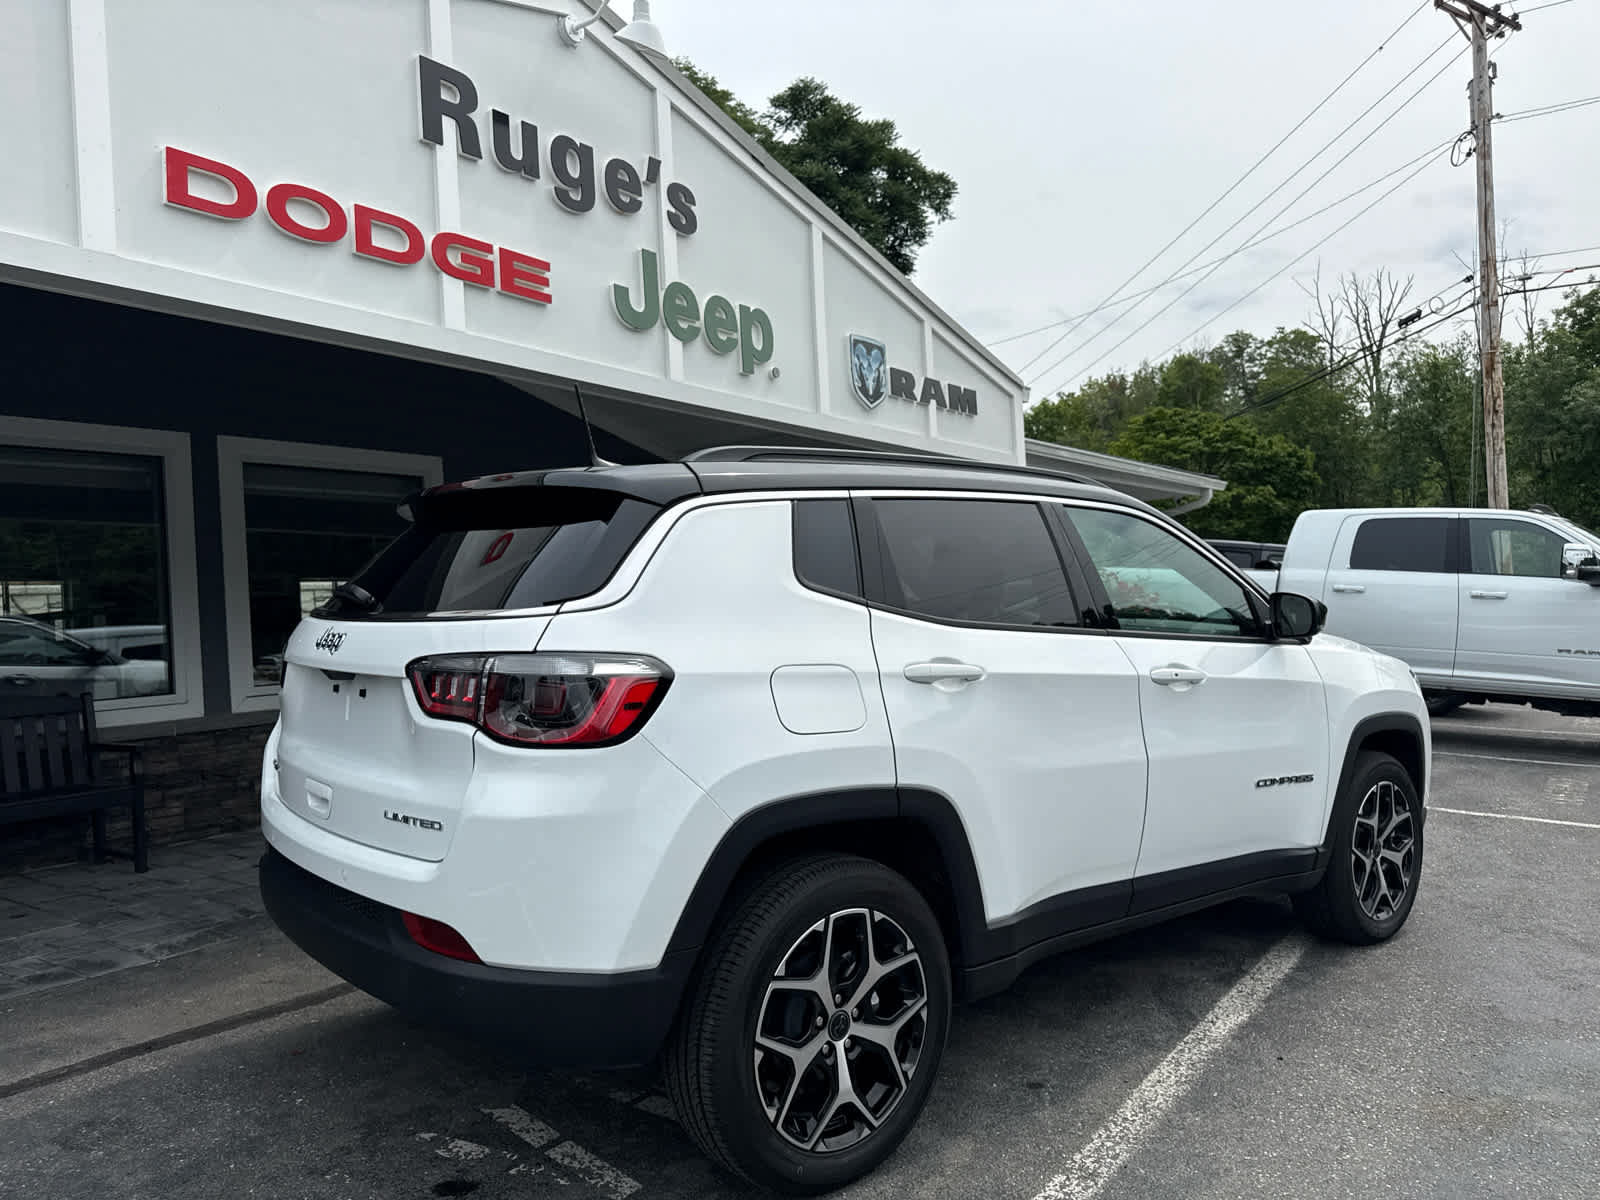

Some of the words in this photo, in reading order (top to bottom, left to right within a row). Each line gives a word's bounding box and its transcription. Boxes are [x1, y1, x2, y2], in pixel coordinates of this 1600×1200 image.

[418, 54, 698, 236] Ruge's
[163, 145, 553, 305] DODGE
[889, 366, 979, 416] RAM
[1255, 774, 1314, 789] COMPASS
[384, 809, 443, 832] LIMITED
